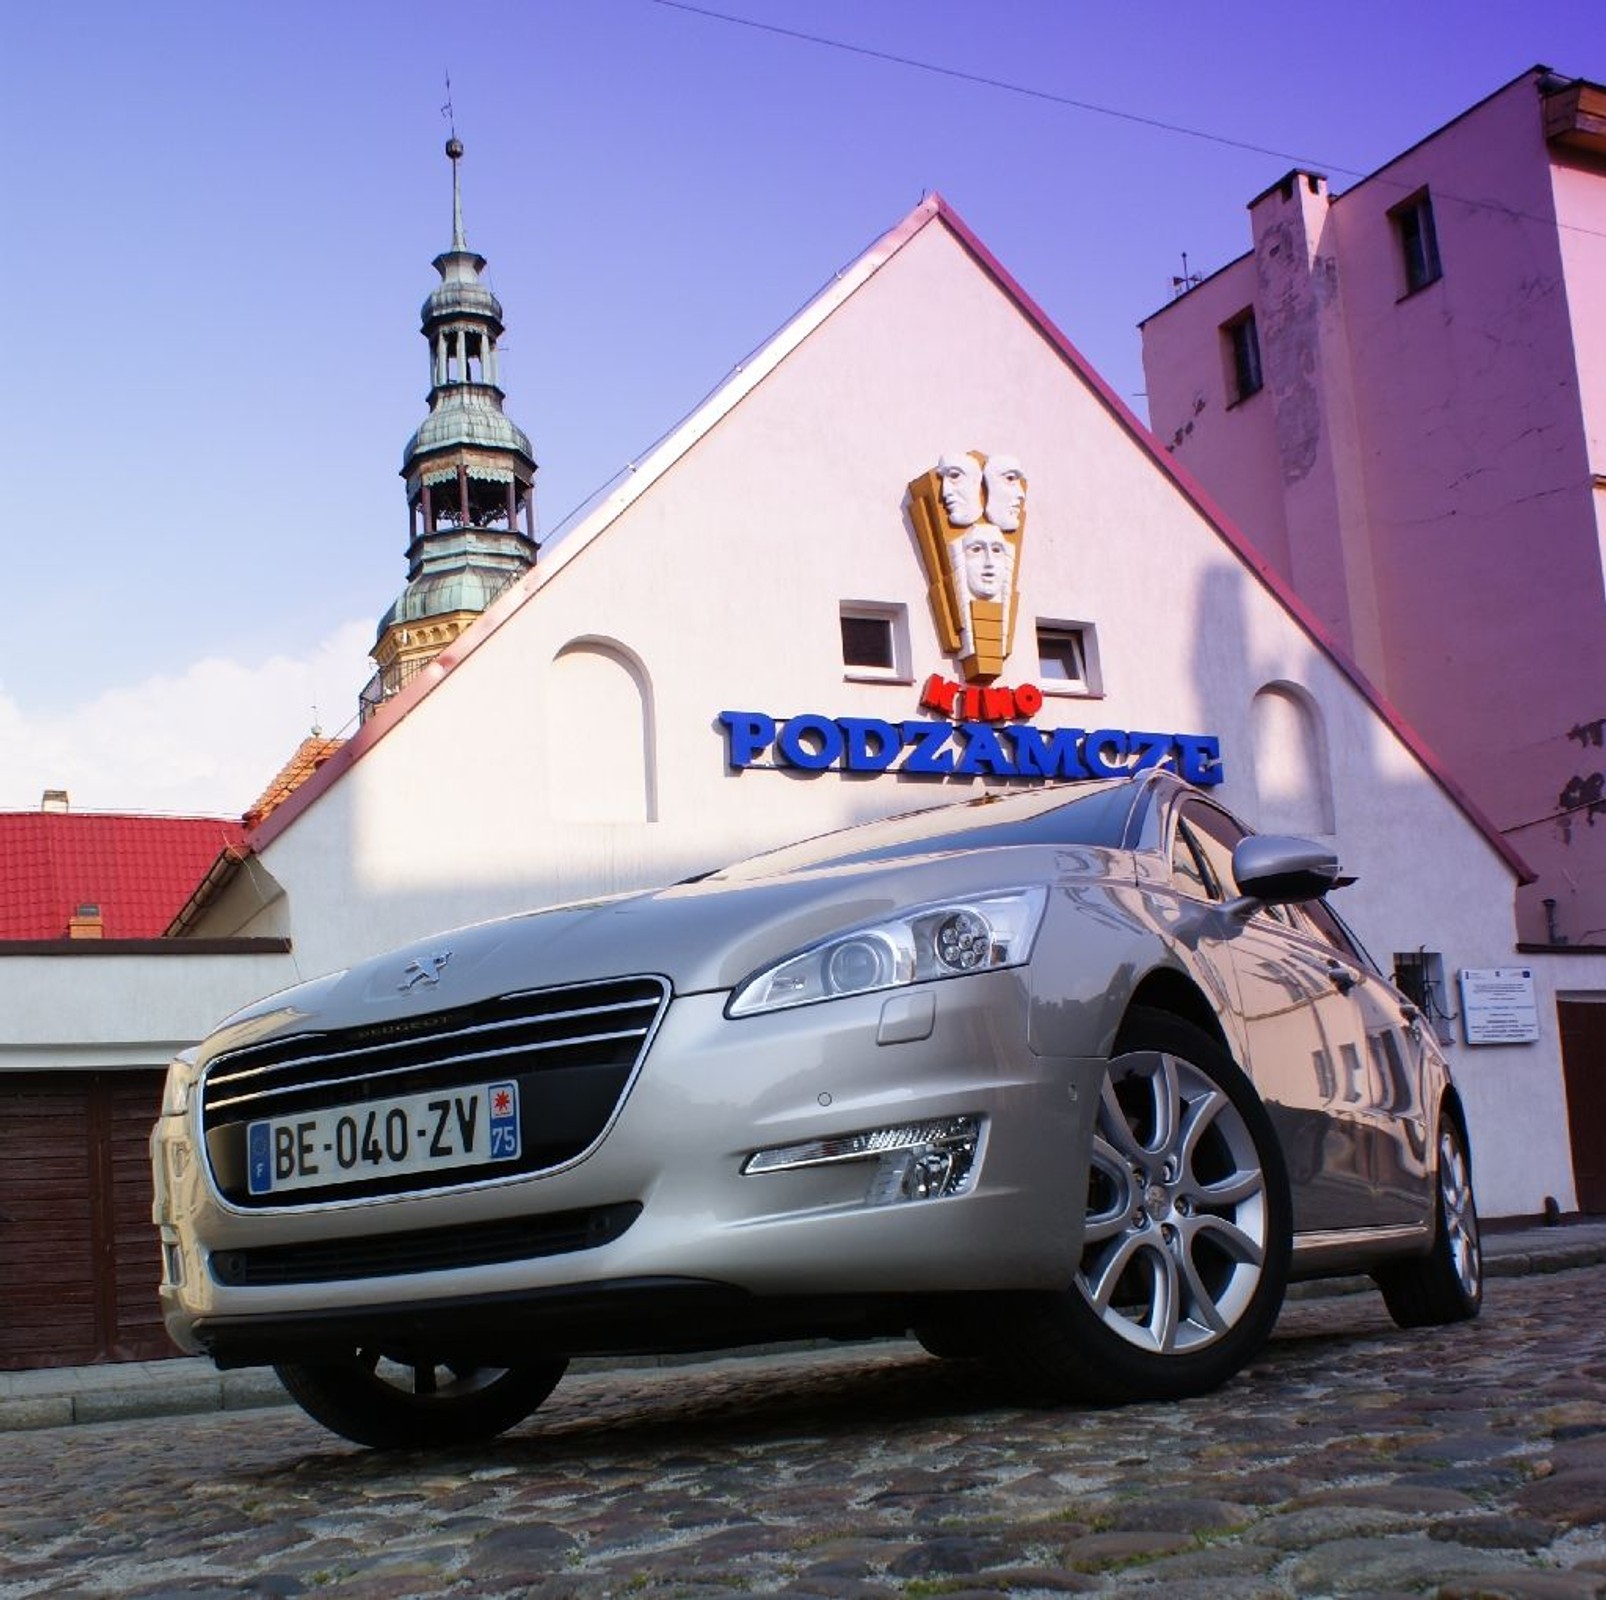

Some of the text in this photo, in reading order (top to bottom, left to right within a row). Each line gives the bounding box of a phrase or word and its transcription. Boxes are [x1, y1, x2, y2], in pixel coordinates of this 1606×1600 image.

[920, 673, 1042, 720] KINO
[720, 711, 1223, 784] PODZAMCZE
[275, 1096, 478, 1180] BE-040-ZV
[492, 1126, 515, 1155] 75
[256, 1163, 263, 1178] F
